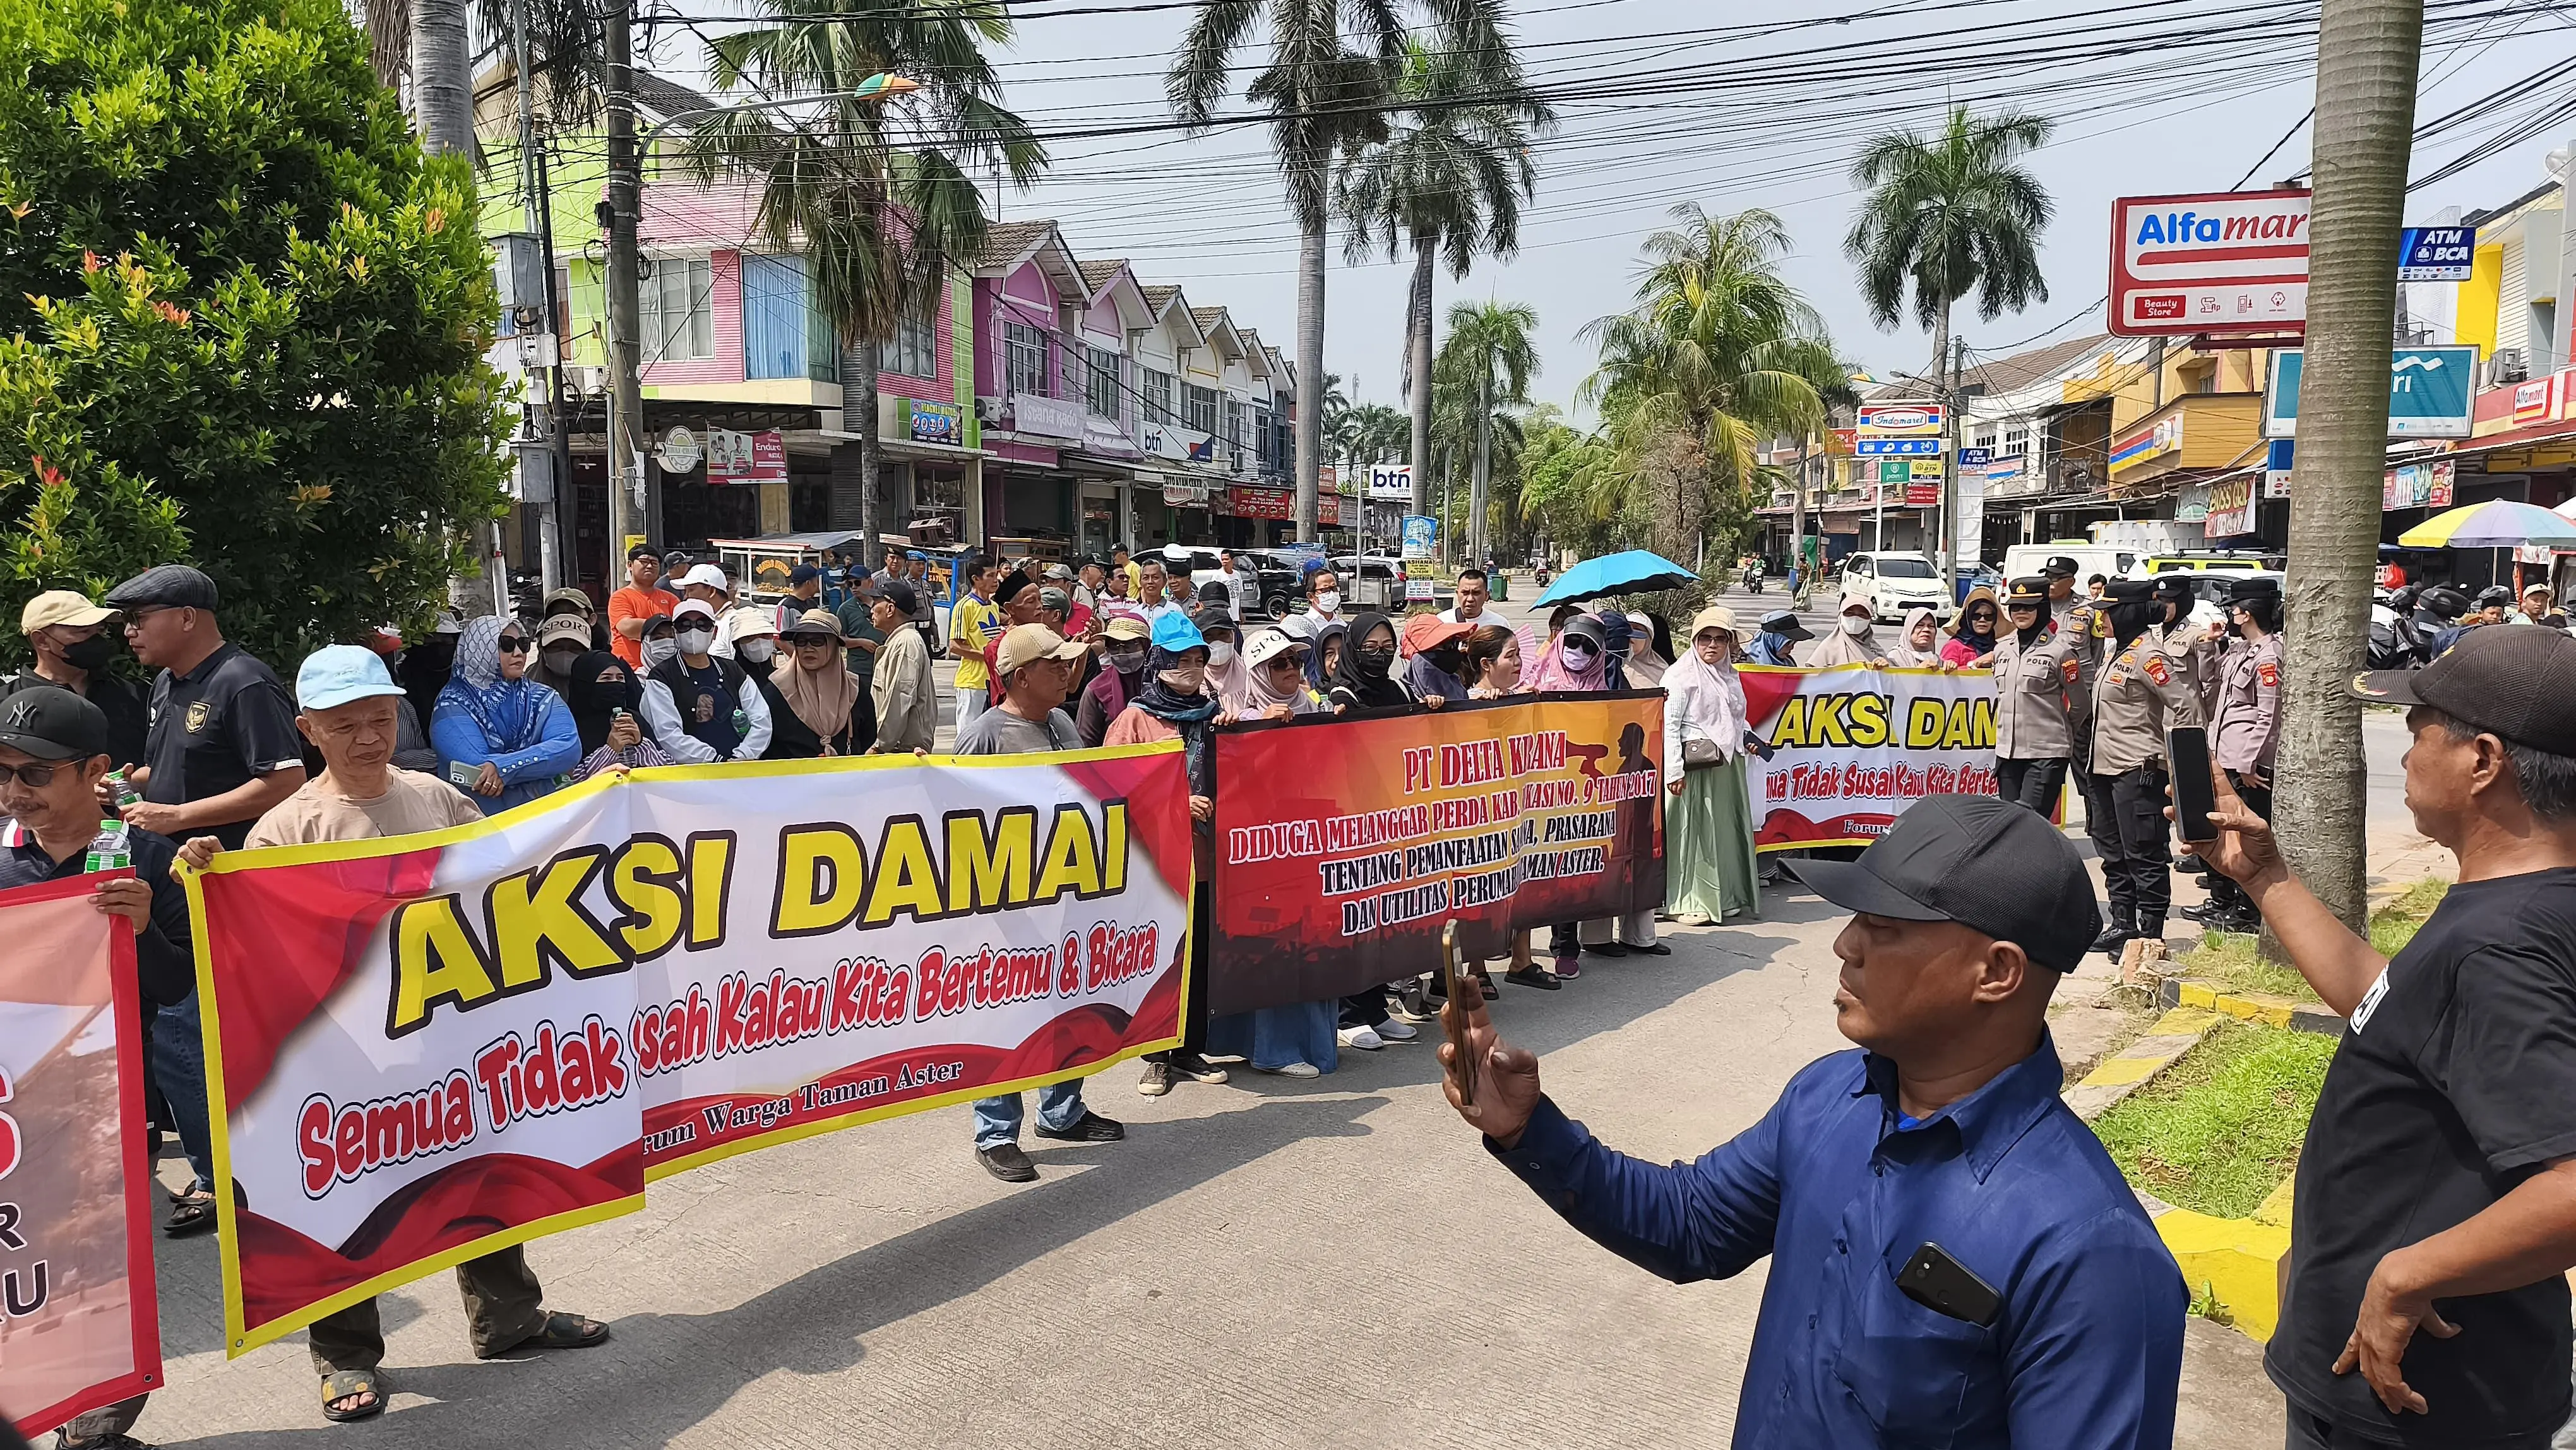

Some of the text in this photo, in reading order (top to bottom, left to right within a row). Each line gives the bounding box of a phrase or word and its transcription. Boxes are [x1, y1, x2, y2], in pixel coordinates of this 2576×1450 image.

[2137, 212, 2309, 245] Alfamar
[2423, 230, 2462, 244] ATM
[2433, 246, 2468, 261] BCA
[2144, 299, 2178, 309] Beauty
[2147, 308, 2171, 316] Store
[2515, 385, 2544, 404] Alfamart
[1875, 416, 1924, 425] Indomaret
[756, 442, 782, 451] Enduro
[1145, 429, 1162, 452] btn
[1373, 468, 1410, 488] btn
[544, 620, 588, 635] SPORT
[2027, 658, 2051, 666] POLRI
[2113, 662, 2133, 674] POLRI
[1905, 697, 1998, 750] DAM
[1402, 746, 1433, 794] PT
[1439, 738, 1506, 788] DELTA
[1791, 761, 1842, 800] Tidak
[1925, 762, 1957, 794] Kita
[1229, 820, 1323, 865] DIDUGA
[1325, 804, 1429, 852] MELANGGAR
[1431, 794, 1488, 834] PERDA
[1556, 779, 1578, 807] NO.
[1583, 777, 1594, 806] 9
[1597, 772, 1628, 804] TAHUN
[1628, 770, 1657, 800] 2017
[1319, 849, 1402, 896] TENTANG
[1405, 831, 1509, 879] PEMANFAATAN
[1542, 809, 1616, 843] PRASARANA
[1341, 894, 1378, 936] DAN
[1380, 878, 1449, 926] UTILITAS
[1556, 846, 1605, 877] ASTER.
[386, 796, 1130, 1040] AKSI DAMAI
[297, 1068, 478, 1201] Semua
[474, 1014, 629, 1134] Tidak
[713, 968, 828, 1060] Kalau
[827, 956, 912, 1036] Kita
[914, 942, 1056, 1022] Bertemu
[1056, 930, 1081, 999] &
[1086, 920, 1159, 995] Bicara
[703, 1095, 792, 1135] Warga
[800, 1075, 888, 1110] Taman
[895, 1060, 963, 1090] Aster
